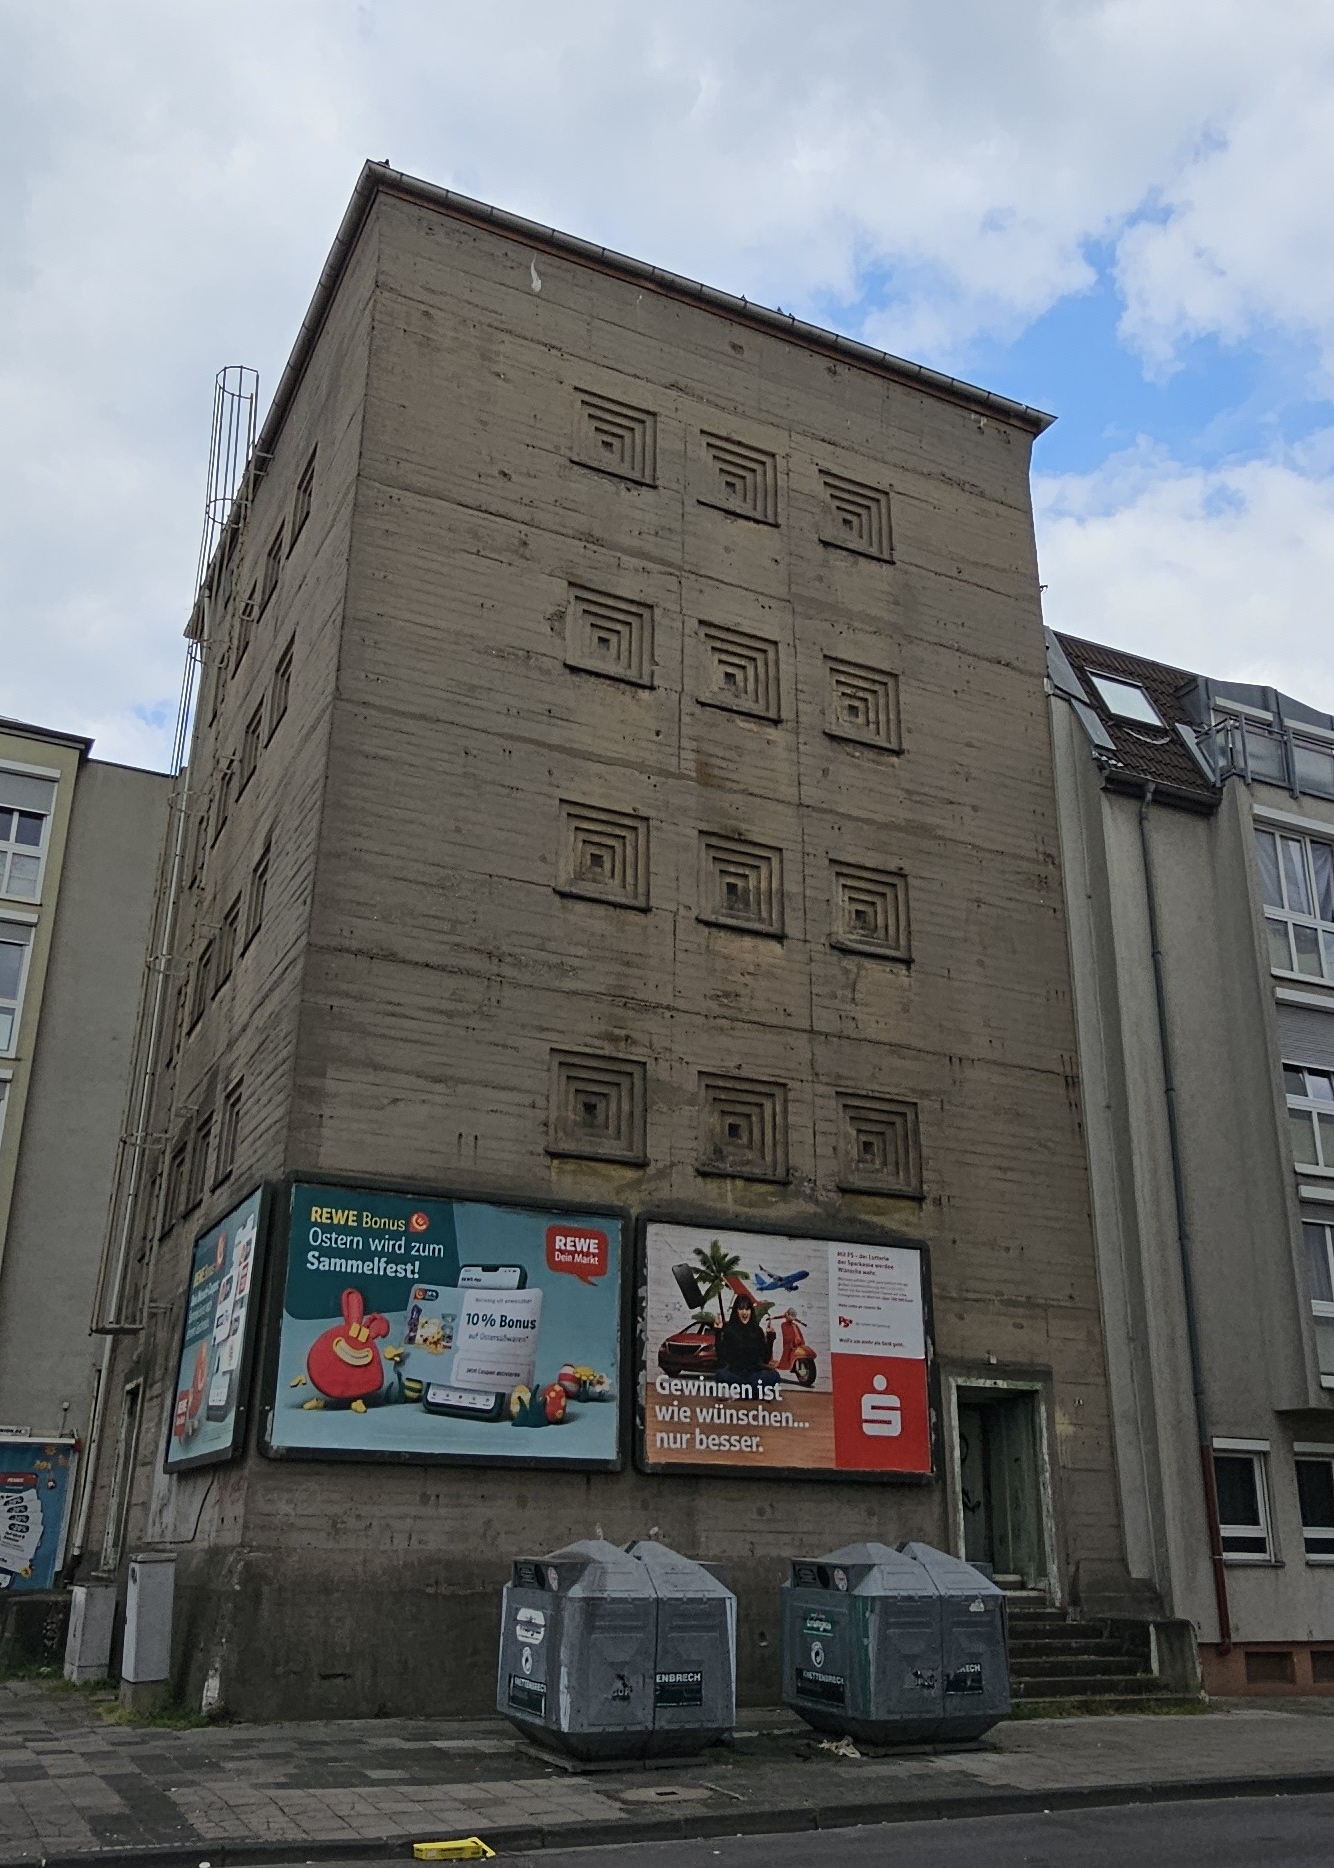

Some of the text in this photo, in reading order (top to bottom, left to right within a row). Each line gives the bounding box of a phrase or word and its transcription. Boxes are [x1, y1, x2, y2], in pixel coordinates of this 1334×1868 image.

[311, 1206, 406, 1231] REWE Bonus
[308, 1227, 444, 1258] Ostern wird zum
[555, 1235, 599, 1253] REWE
[306, 1251, 419, 1279] Sammelfest!
[554, 1251, 599, 1265] Dein Markt
[466, 1313, 537, 1330] 10 % Bonus
[655, 1374, 783, 1400] Gewinnen ist
[655, 1400, 810, 1428] wie wünschen...
[655, 1428, 764, 1452] nur besser.
